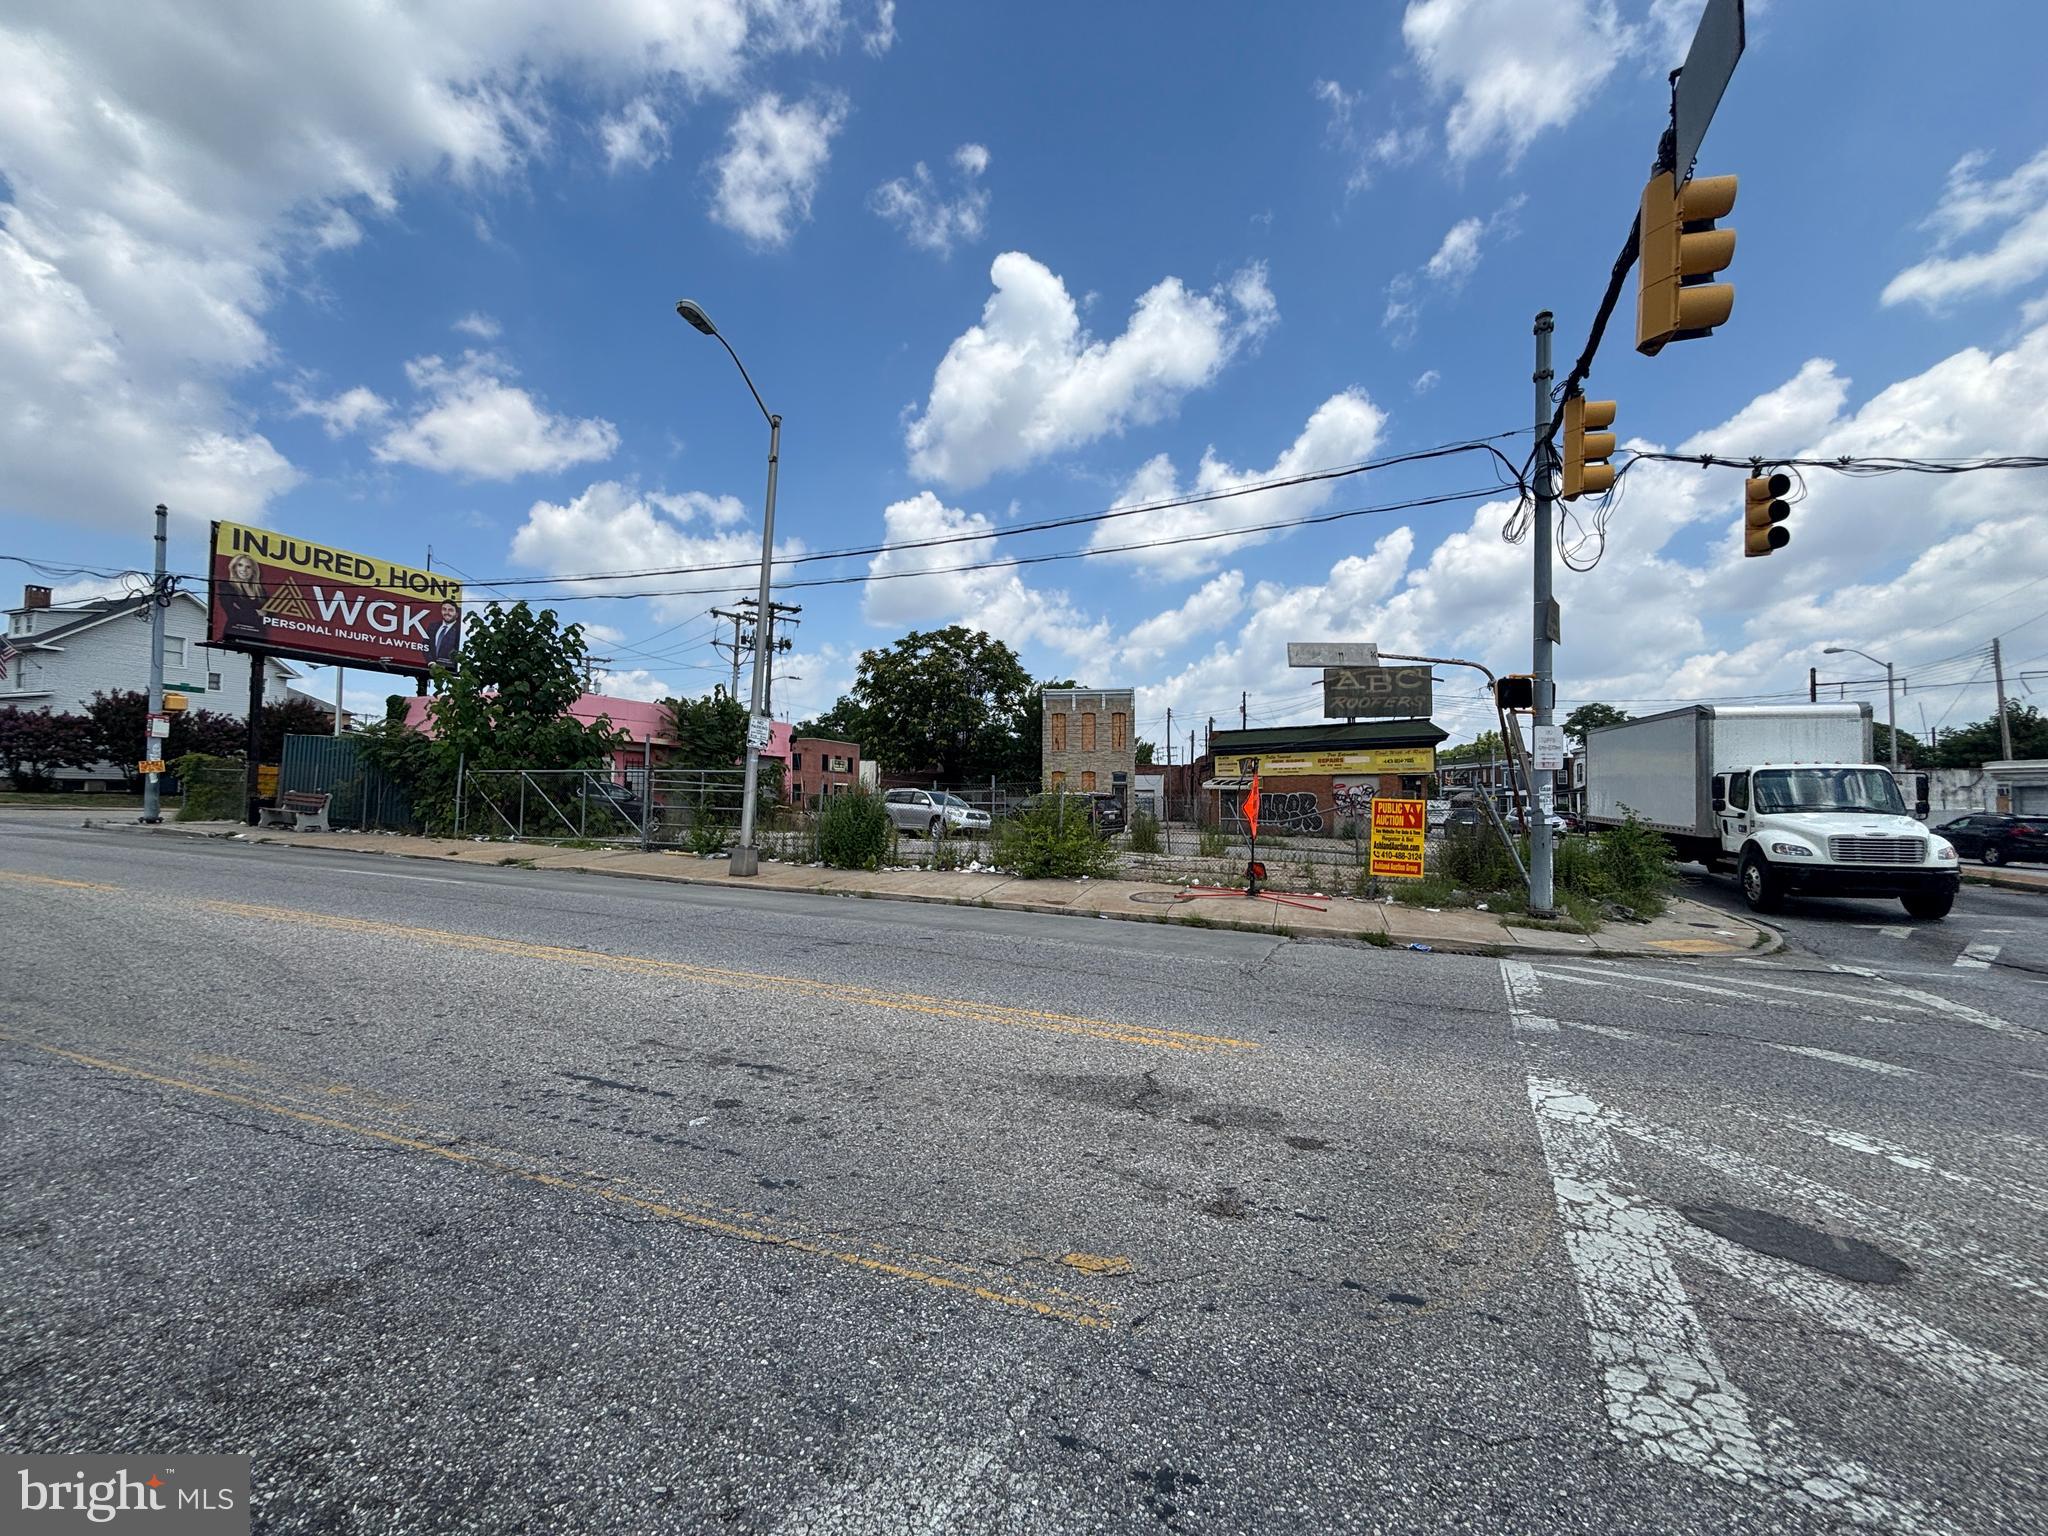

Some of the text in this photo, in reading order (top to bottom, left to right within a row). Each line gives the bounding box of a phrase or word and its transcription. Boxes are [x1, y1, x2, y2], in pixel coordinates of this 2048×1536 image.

[232, 528, 460, 600] INJURED, HON?
[312, 586, 431, 640] WGK
[262, 616, 332, 636] PERSONAL
[335, 628, 377, 643] INJURY
[379, 636, 430, 652] LAWYERS
[1330, 668, 1425, 693] ABC
[1329, 695, 1426, 710] ROOFERS
[1378, 803, 1403, 814] PUBLIC
[1375, 814, 1405, 826] AUCTION
[1374, 841, 1420, 851] AshlandAuction.com
[1380, 851, 1422, 860] 410-488-3124
